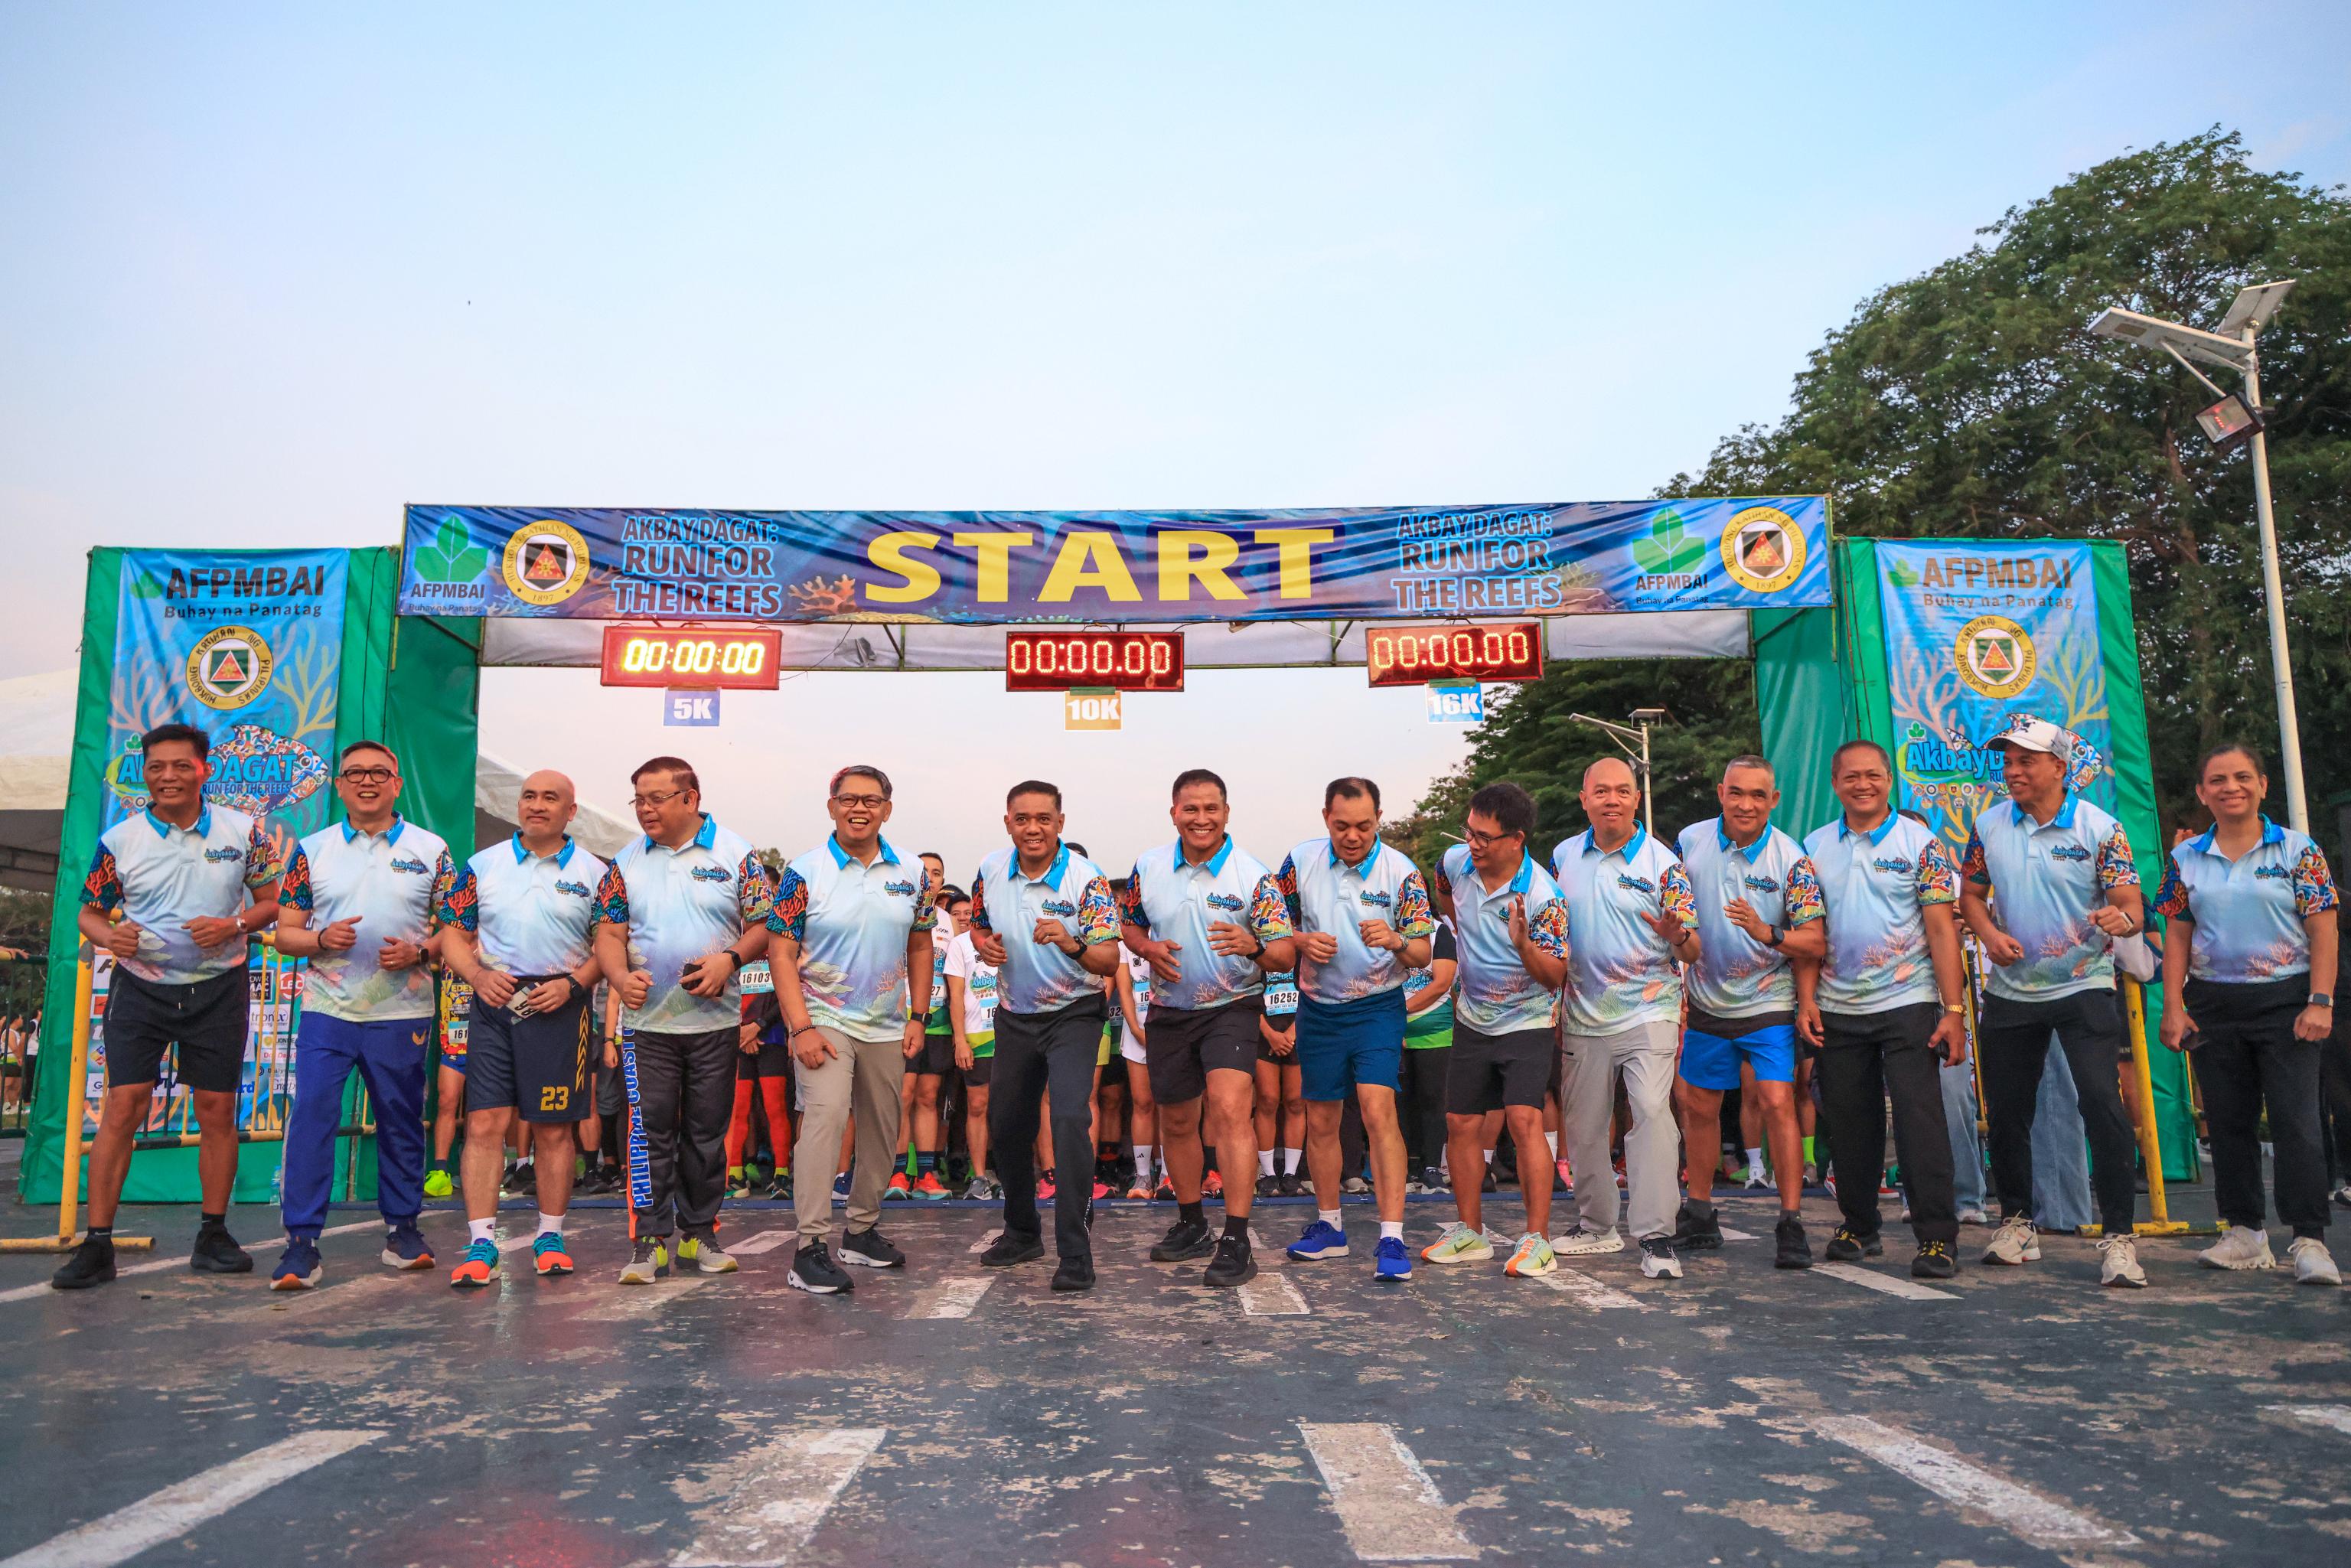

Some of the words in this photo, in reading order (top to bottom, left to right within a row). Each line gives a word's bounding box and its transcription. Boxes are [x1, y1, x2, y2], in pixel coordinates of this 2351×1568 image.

[624, 544, 699, 575] RUN
[706, 545, 773, 577] FOR
[1401, 540, 1475, 571] RUN
[1482, 539, 1551, 570] FOR
[866, 529, 1334, 604] START
[1923, 556, 2072, 589] AFPMBAI
[166, 566, 324, 599] AFPMBAI
[410, 583, 485, 599] AFPMBAI
[1392, 579, 1456, 610] THE
[1464, 576, 1560, 608] REEFS
[1635, 574, 1708, 591] AFPMBAI
[1756, 581, 1776, 589] 1897
[532, 594, 554, 602] 1897
[613, 582, 676, 612] THE
[683, 582, 781, 615] REEFS
[1636, 596, 1661, 605] Buhay
[1924, 593, 1974, 608] Buhay
[1981, 596, 2000, 607] na
[2006, 594, 2074, 610] Panatag
[164, 605, 217, 620] Buhay
[223, 607, 243, 616] na
[249, 602, 322, 618] Panatag
[623, 638, 766, 675] 00:00:00
[673, 699, 712, 720] 5K
[1066, 698, 1120, 722] 10K
[1428, 692, 1482, 716] 16K
[201, 783, 223, 794] RUN
[224, 783, 243, 794] FOR
[245, 782, 263, 794] THE
[264, 781, 292, 794] REEFS
[742, 972, 771, 984] 16103
[1270, 992, 1297, 1005] 16252
[454, 1029, 468, 1039] 161
[540, 1086, 569, 1111] 23
